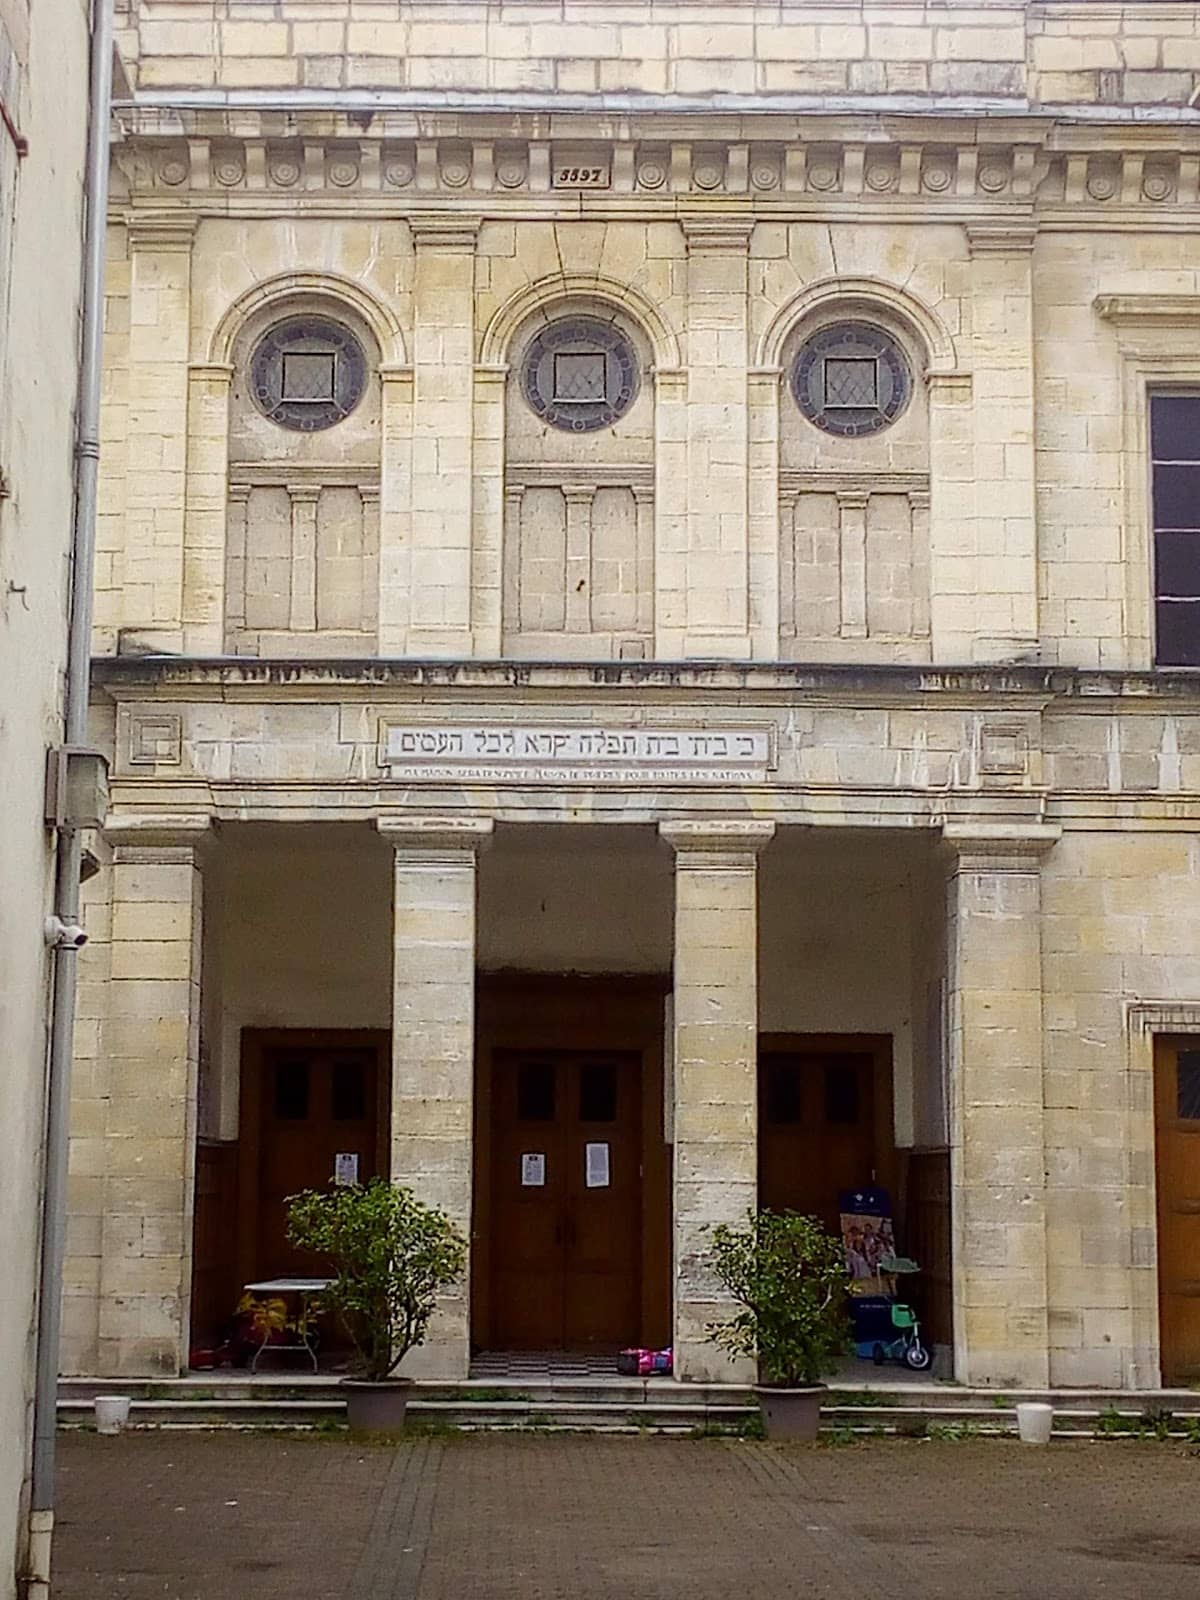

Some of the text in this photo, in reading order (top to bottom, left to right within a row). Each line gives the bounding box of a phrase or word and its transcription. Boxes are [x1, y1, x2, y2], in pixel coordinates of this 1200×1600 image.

[402, 732, 463, 755] העמים
[474, 729, 515, 753] לכל
[525, 734, 571, 757] יקרא
[646, 736, 680, 756] בית
